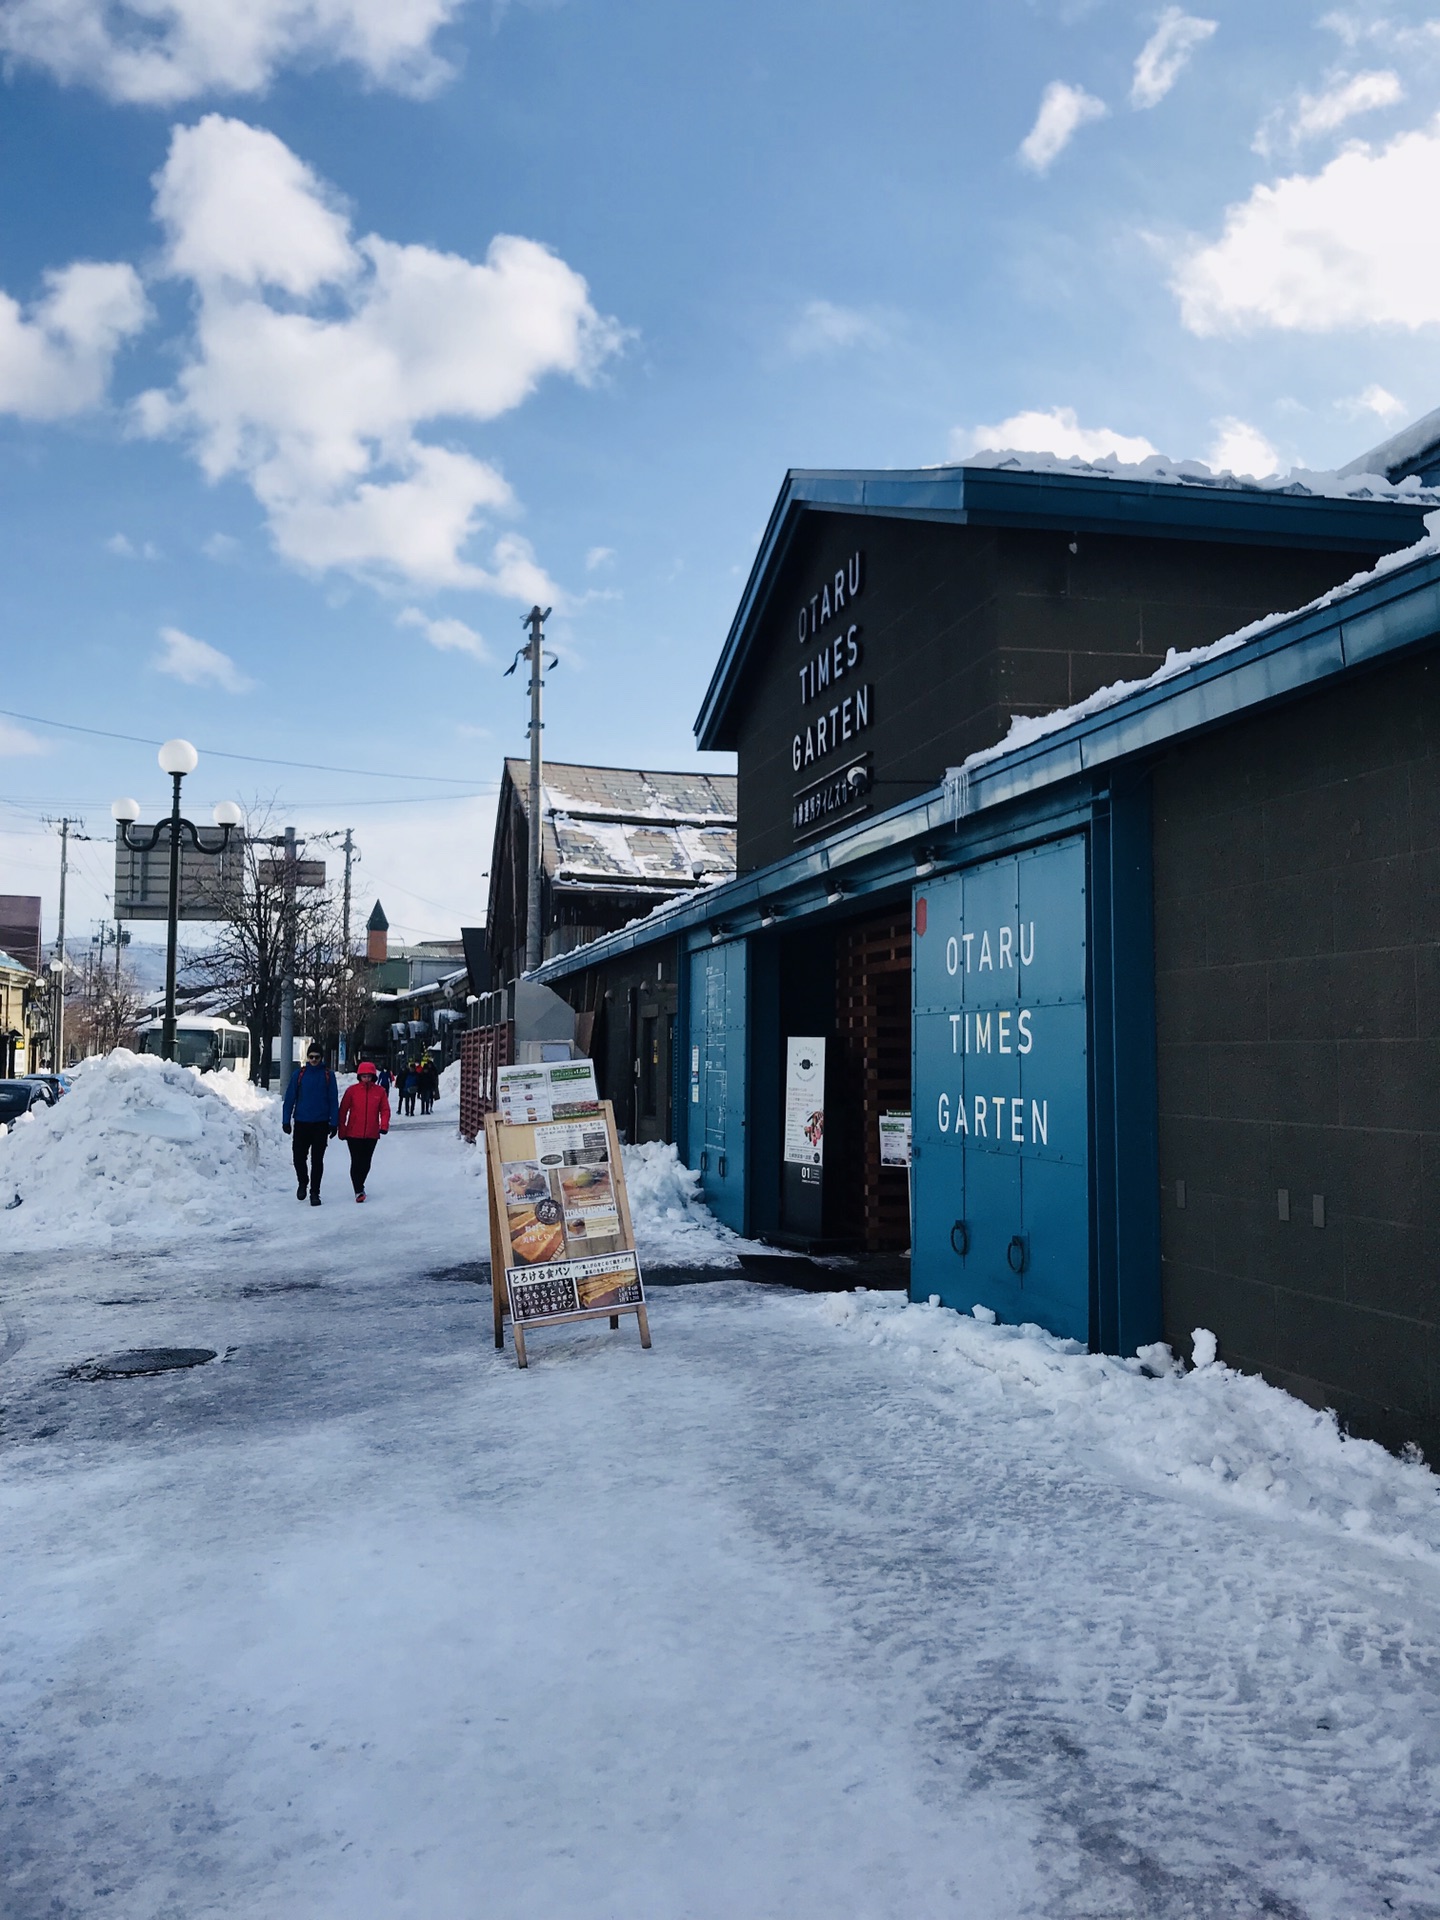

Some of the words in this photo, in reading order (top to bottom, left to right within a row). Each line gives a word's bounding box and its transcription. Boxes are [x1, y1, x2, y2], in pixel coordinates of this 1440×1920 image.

[798, 551, 860, 644] OTARU
[799, 624, 858, 704] TIMES
[792, 684, 868, 771] GARTEN
[946, 921, 1035, 976] OTARU
[949, 1009, 1034, 1055] TIMES
[937, 1092, 1049, 1146] GARTEN
[801, 1166, 811, 1179] 01
[513, 1267, 570, 1284] とろける食パン
[515, 1285, 572, 1302] もちもちとして
